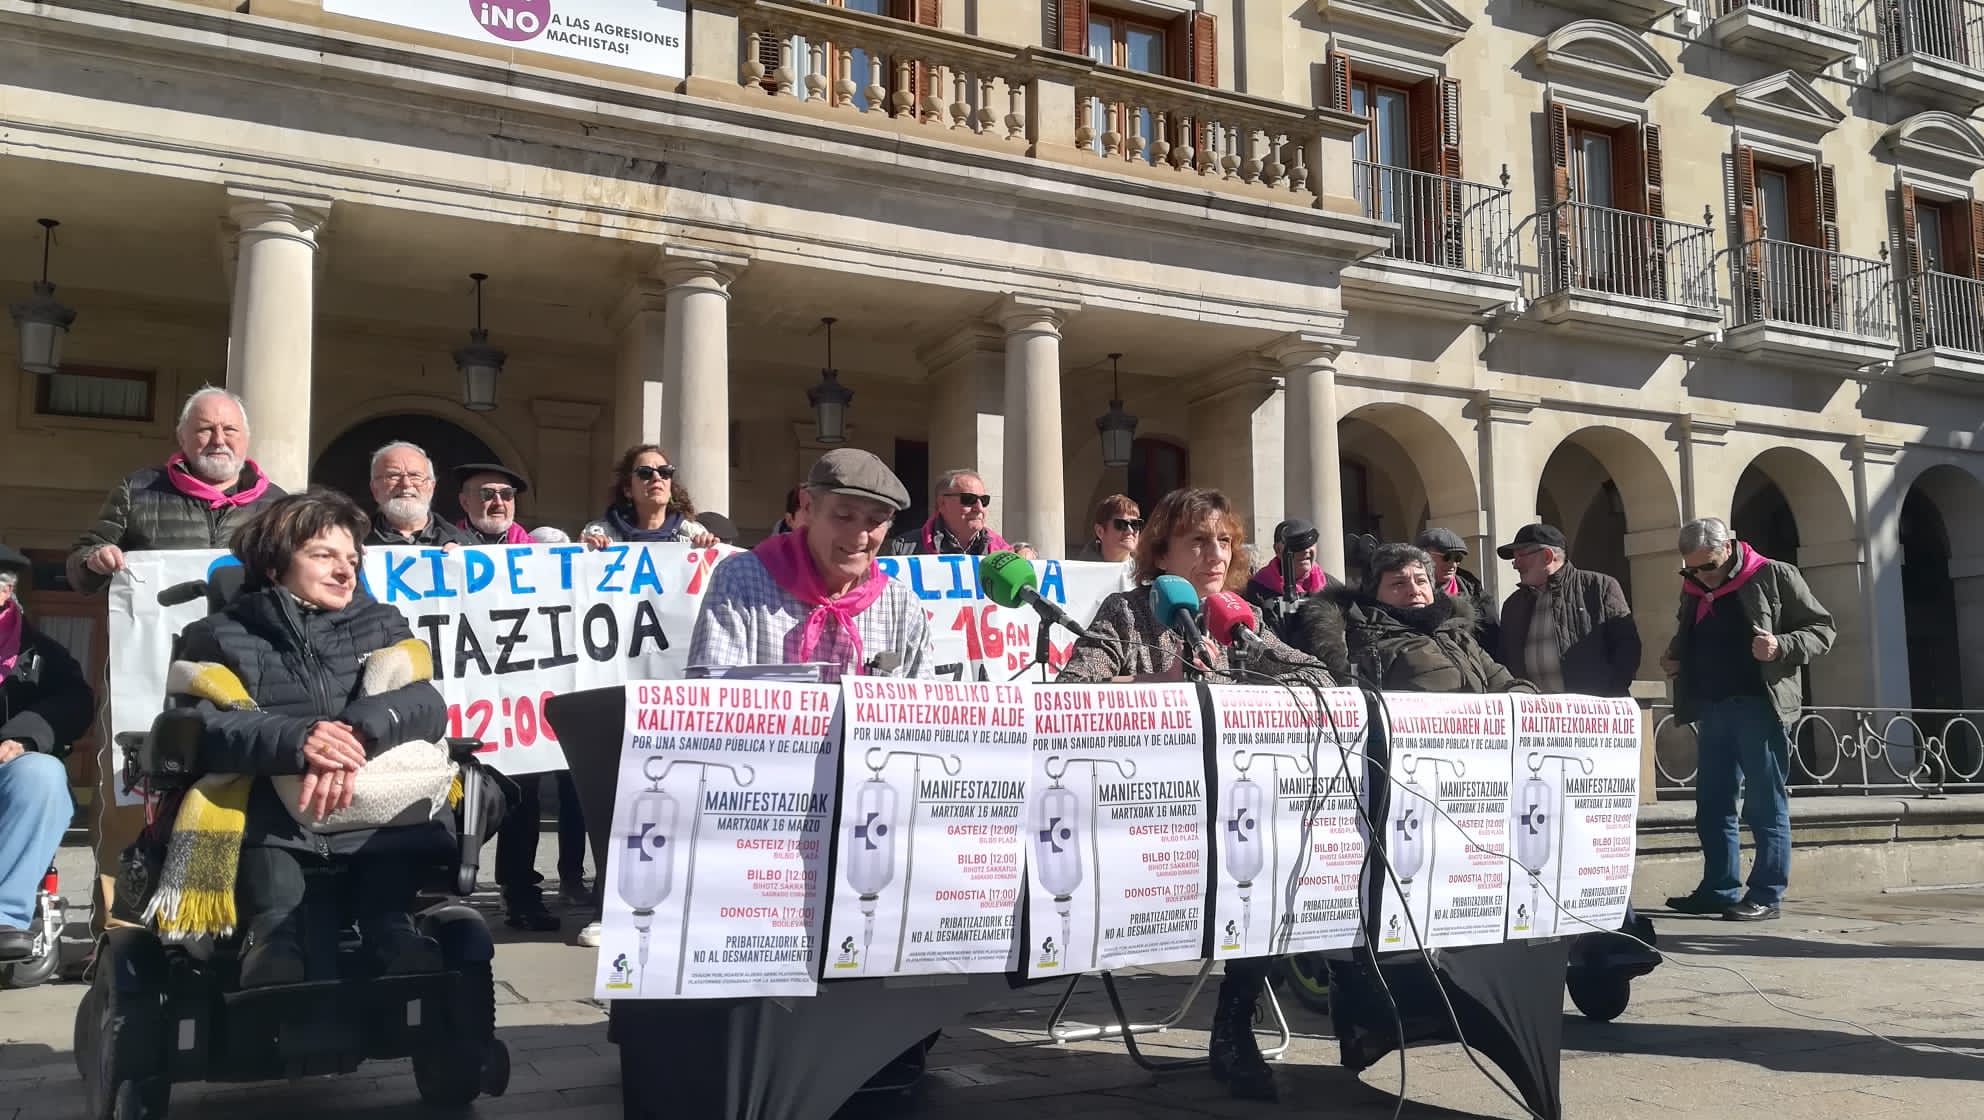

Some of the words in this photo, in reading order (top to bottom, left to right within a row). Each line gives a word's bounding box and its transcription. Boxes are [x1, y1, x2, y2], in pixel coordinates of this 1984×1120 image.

[552, 14, 561, 25] A
[566, 16, 590, 30] LAS
[595, 23, 679, 48] AGRESIONES
[547, 30, 629, 54] MACHISTAS!
[951, 604, 1004, 660] 16
[1006, 622, 1030, 646] AN
[1007, 652, 1030, 671] DE
[639, 686, 710, 706] OSASUN
[720, 688, 791, 710] PUBLIKO
[801, 691, 829, 712] ETA
[854, 682, 917, 700] OSASUN
[924, 684, 989, 702] PUBLIKO
[996, 686, 1022, 704] ETA
[1034, 691, 1091, 711] OSASUN
[1099, 690, 1158, 708] PUBLIKO
[1163, 689, 1188, 707] ETA
[638, 709, 785, 735] KALITATEZKOAREN
[792, 716, 830, 736] ALDE
[856, 703, 986, 726] KALITATEZKOAREN
[992, 708, 1024, 727] ALDE
[1035, 712, 1156, 734] KALITATEZKOAREN
[1161, 711, 1192, 729] ALDE
[1333, 710, 1359, 728] ALDE
[1392, 717, 1479, 734] KALITATEZKOAREN
[1484, 719, 1505, 735] ALDE
[1522, 717, 1608, 733] KALITATEZKOAREN
[1612, 719, 1634, 734] ALDE
[854, 728, 870, 740] POR
[874, 728, 891, 741] UNA
[894, 729, 931, 742] SANIDAD
[935, 727, 969, 742] PÚBLICA
[972, 731, 976, 743] Y
[980, 731, 989, 743] DE
[994, 732, 1027, 744] CALIDAD
[1033, 738, 1048, 751] POR
[1052, 738, 1067, 750] UNA
[1071, 736, 1105, 749] SANIDAD
[1108, 733, 1141, 748] PÚBLICA
[1144, 735, 1148, 746] Y
[1152, 735, 1161, 745] DE
[1164, 733, 1196, 745] CALIDAD
[1223, 733, 1236, 744] POR
[1239, 733, 1252, 744] UNA
[1255, 732, 1284, 744] SANIDAD
[1520, 737, 1530, 747] POR
[1533, 737, 1544, 747] UNA
[1547, 737, 1572, 748] SANIDAD
[1600, 738, 1603, 748] Y
[1605, 738, 1612, 748] DE
[1614, 738, 1636, 748] CALIDAD
[632, 736, 653, 749] POR
[656, 736, 675, 750] UNA
[679, 737, 721, 751] SANIDAD
[725, 736, 764, 753] PÚBLICA
[770, 740, 774, 752] Y
[778, 740, 789, 753] DE
[792, 741, 831, 754] CALIDAD
[1393, 738, 1403, 748] POR
[1406, 738, 1417, 748] UNA
[1420, 738, 1444, 748] SANIDAD
[1471, 739, 1474, 749] Y
[1476, 740, 1482, 749] DE
[1485, 740, 1508, 750] CALIDAD
[920, 780, 1025, 799] MANIFESTAZIOAK
[1100, 780, 1200, 802] MANIFESTAZIOAK
[1440, 781, 1508, 797] MANIFESTAZIOAK
[1566, 778, 1636, 793] MANIFESTAZIOAK
[705, 791, 828, 812] MANIFESTAZIOAK
[1486, 803, 1504, 813] MARZO
[931, 806, 975, 818] MARTXOAK
[978, 806, 988, 817] 16
[991, 806, 1018, 818] MARZO
[1112, 806, 1154, 820] MARTXOAK
[1157, 806, 1166, 817] 16
[1170, 804, 1196, 816] MARZO
[718, 818, 769, 830] MARTXOAK
[772, 819, 784, 831] 16
[788, 819, 820, 832] MARZO
[947, 825, 987, 835] GASTEIZ
[1130, 825, 1168, 835] GASTEIZ
[737, 839, 784, 849] GASTEIZ
[1315, 844, 1338, 852] BILBO
[958, 854, 987, 864] BILBO
[1142, 852, 1170, 862] BILBO
[748, 870, 782, 880] BILBO
[1449, 874, 1482, 883] DONOSTIA
[936, 890, 986, 900] DONOSTIA
[1125, 886, 1170, 898] DONOSTIA
[720, 908, 778, 918] DONOSTIA
[1130, 909, 1186, 924] PRIBATIZAZIORIK
[1301, 909, 1360, 923] DESMANTELAMIENT
[940, 916, 1002, 928] PRIBATIZAZIORIK
[1105, 928, 1114, 939] NO
[1116, 928, 1124, 938] AL
[1128, 920, 1197, 936] DESMANTELAMIENTO
[726, 936, 798, 948] PRIBATIZAZIORIK
[802, 936, 814, 948] EZ!
[912, 931, 921, 943] NO
[924, 931, 934, 942] AL
[936, 929, 1014, 941] DESMANTELAMIENTO
[694, 951, 705, 962] NO
[709, 951, 719, 962] AL
[722, 950, 813, 962] DESMANTELAMIENTO
